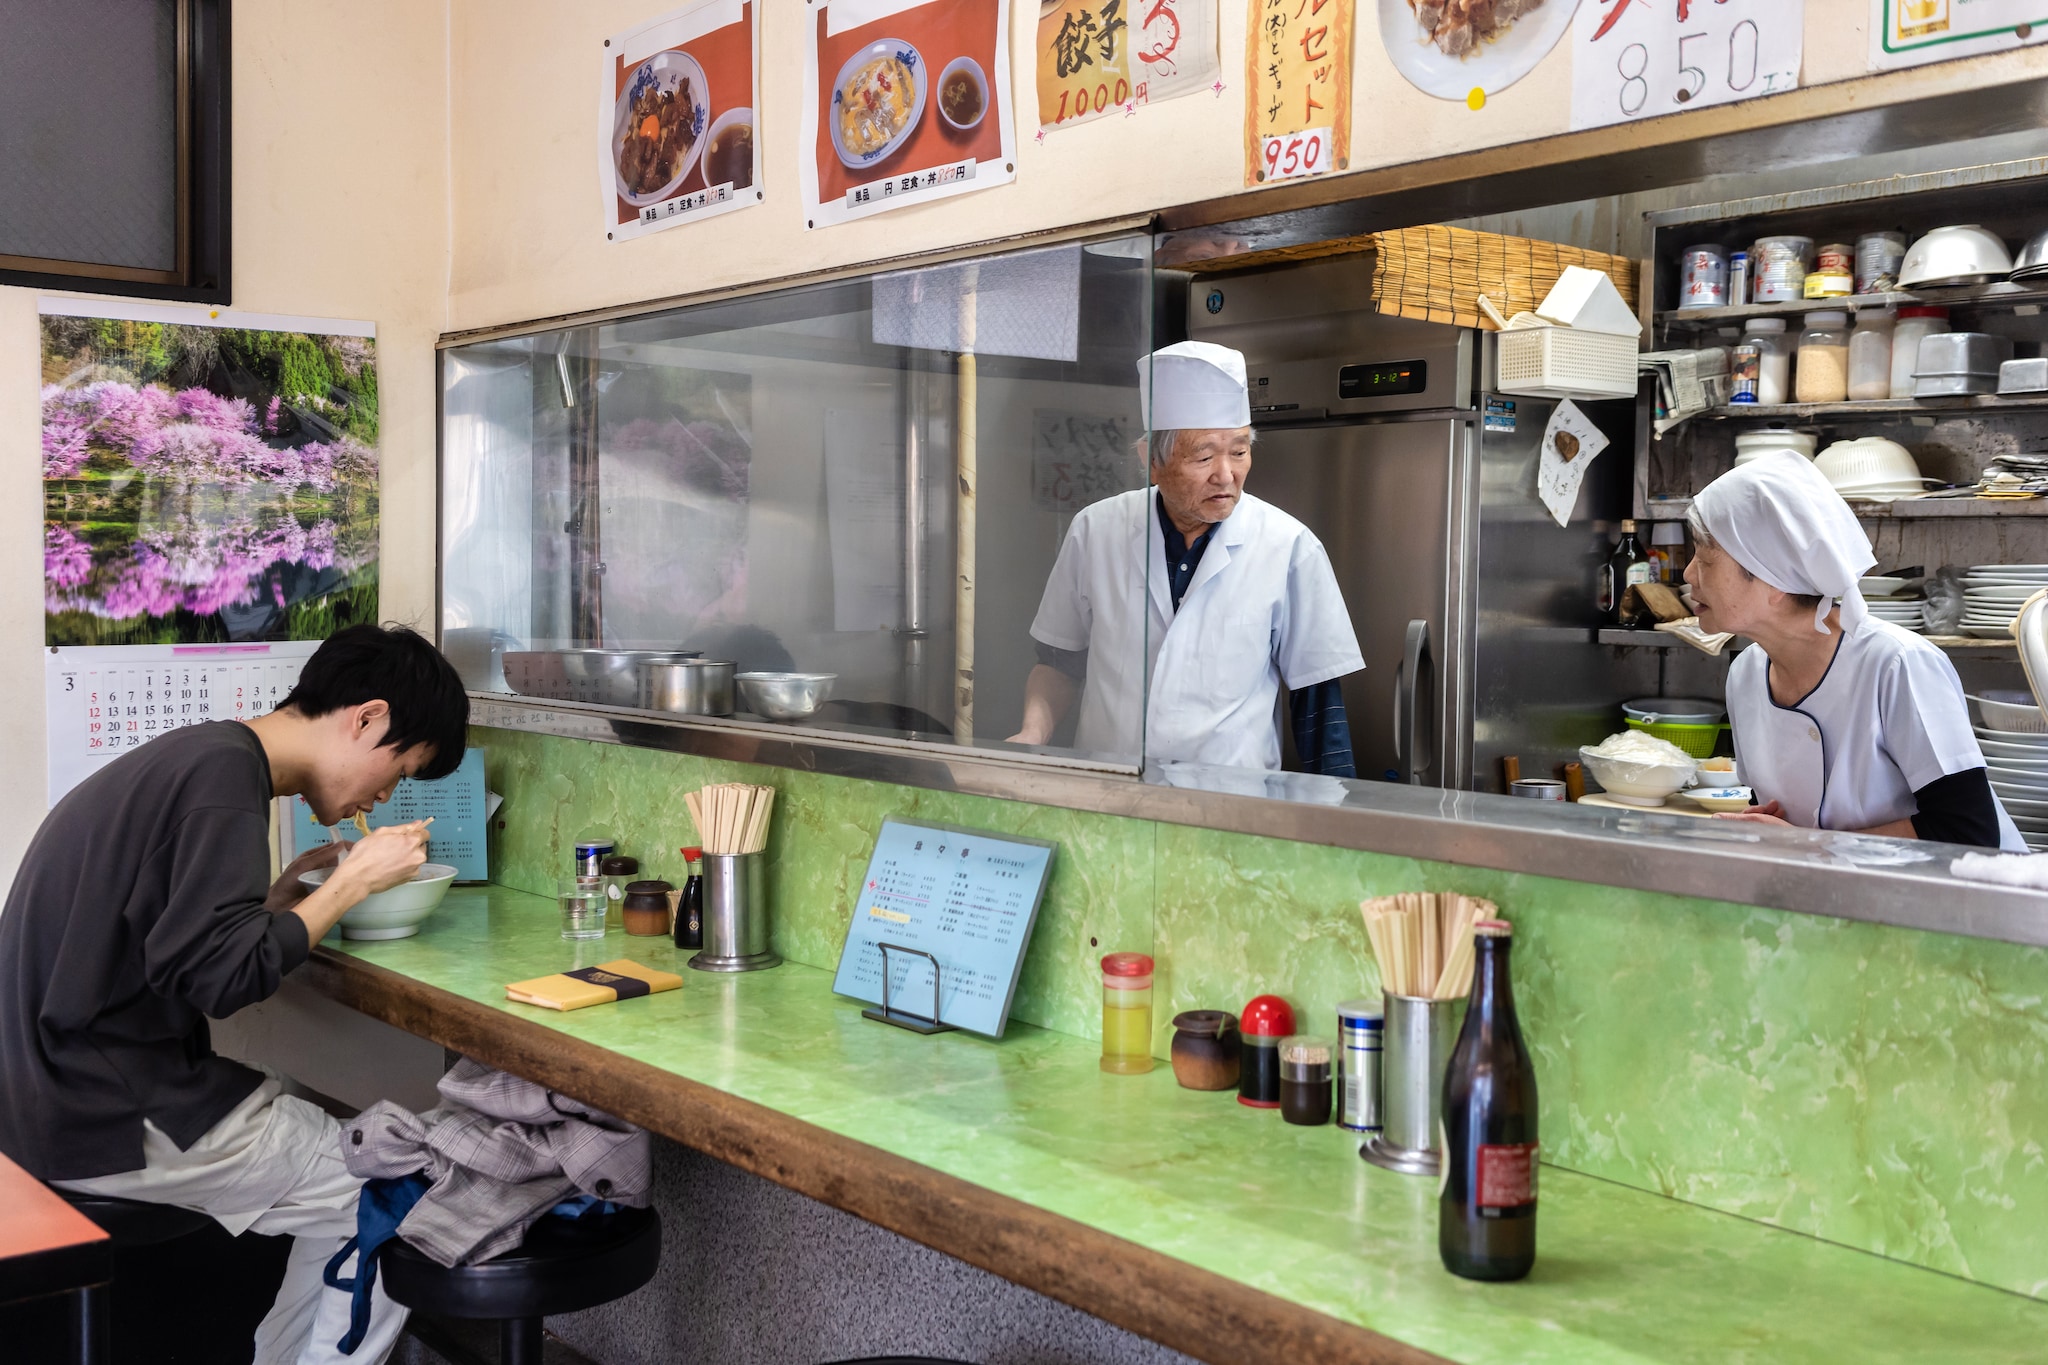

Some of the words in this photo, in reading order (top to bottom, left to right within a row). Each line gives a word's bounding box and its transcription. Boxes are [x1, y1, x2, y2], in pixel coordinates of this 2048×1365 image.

[1618, 20, 1758, 116] 850
[1265, 135, 1321, 176] 950
[855, 188, 870, 203] 単品
[885, 182, 893, 195] 円
[645, 208, 657, 220] 単品
[668, 203, 674, 214] 円
[65, 676, 74, 691] 3
[147, 676, 153, 686] 1
[165, 675, 171, 685] 2
[183, 675, 189, 685] 3
[201, 674, 207, 684] 4
[91, 692, 97, 703] 5
[109, 691, 116, 701] 6
[128, 691, 135, 701] 7
[146, 690, 153, 700] 8
[164, 689, 171, 699] 9
[181, 689, 191, 699] 10
[199, 688, 208, 698] 11
[236, 687, 243, 697] 2
[253, 686, 260, 696] 3
[270, 686, 277, 695] 4
[89, 707, 101, 718] 12
[108, 706, 119, 717] 13
[126, 706, 137, 716] 14
[145, 705, 155, 715] 15
[163, 704, 174, 714] 16
[181, 704, 191, 713] 17
[199, 703, 209, 713] 18
[236, 701, 243, 711] 9
[252, 701, 262, 710] 10
[89, 722, 101, 733] 19
[108, 721, 120, 731] 20
[127, 721, 138, 731] 21
[145, 720, 157, 730] 22
[163, 719, 175, 729] 23
[181, 718, 192, 727] 24
[89, 737, 102, 748] 26
[108, 736, 121, 747] 27
[127, 736, 139, 746] 28
